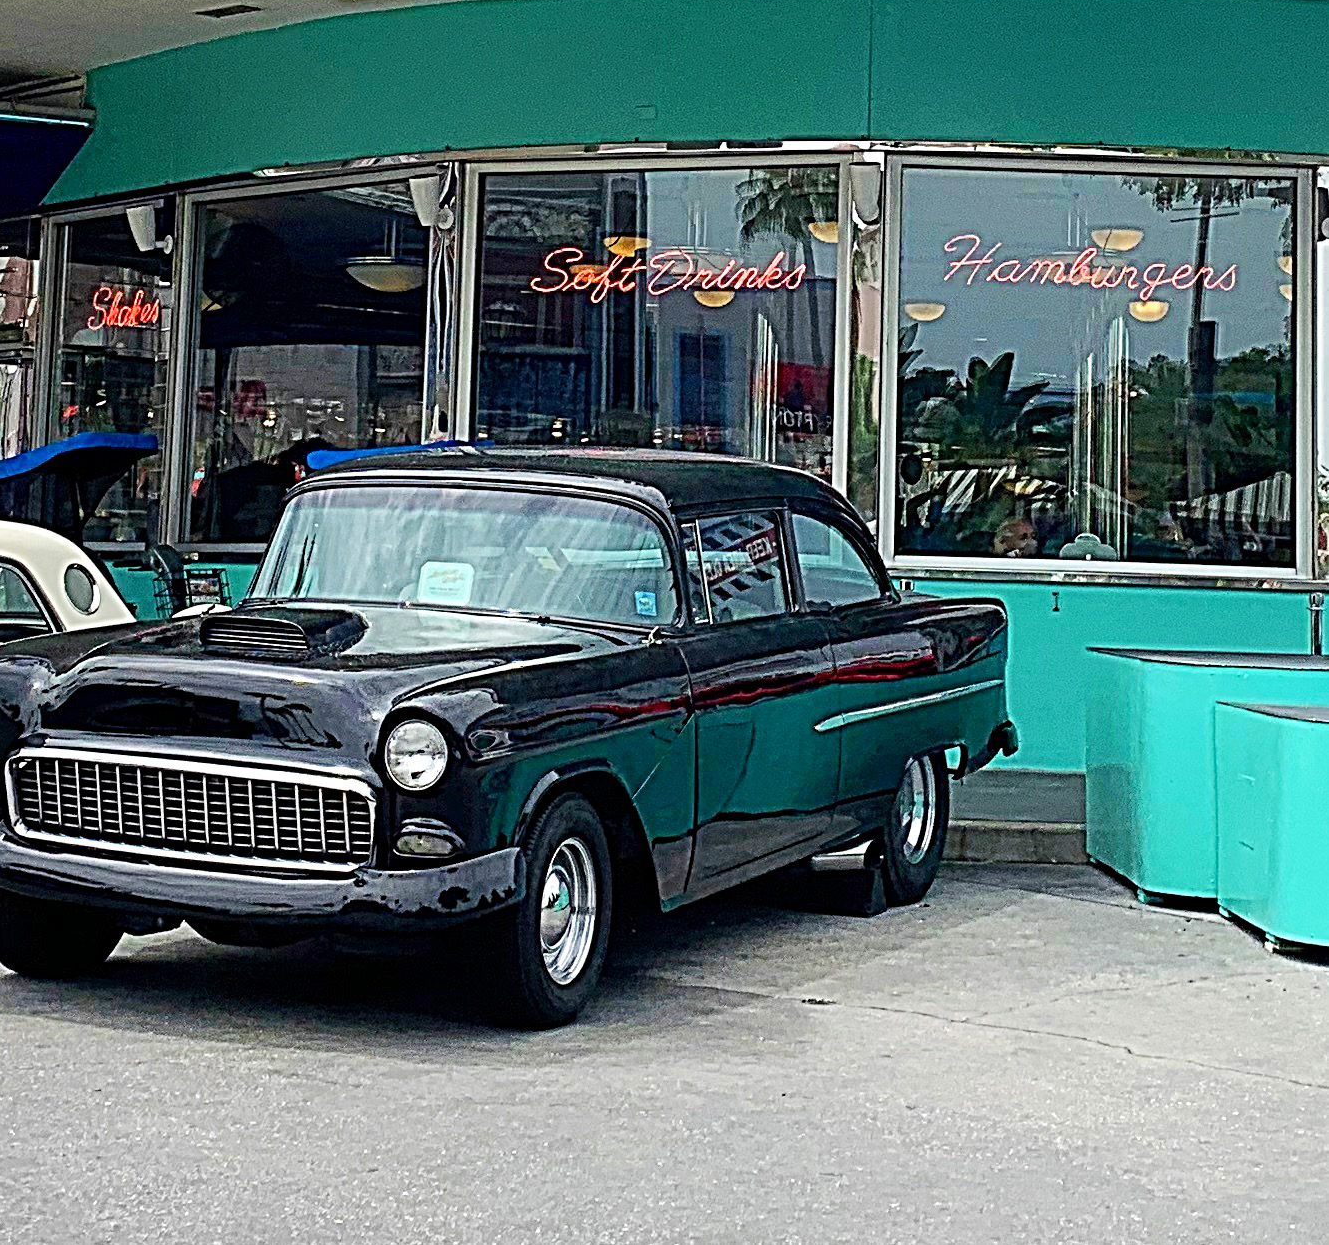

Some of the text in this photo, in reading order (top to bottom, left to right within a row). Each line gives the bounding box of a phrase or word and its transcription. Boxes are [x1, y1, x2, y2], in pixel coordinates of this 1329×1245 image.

[530, 247, 807, 303] Soft Drinks
[943, 234, 1238, 301] Hamburgers
[87, 286, 160, 331] Shakes
